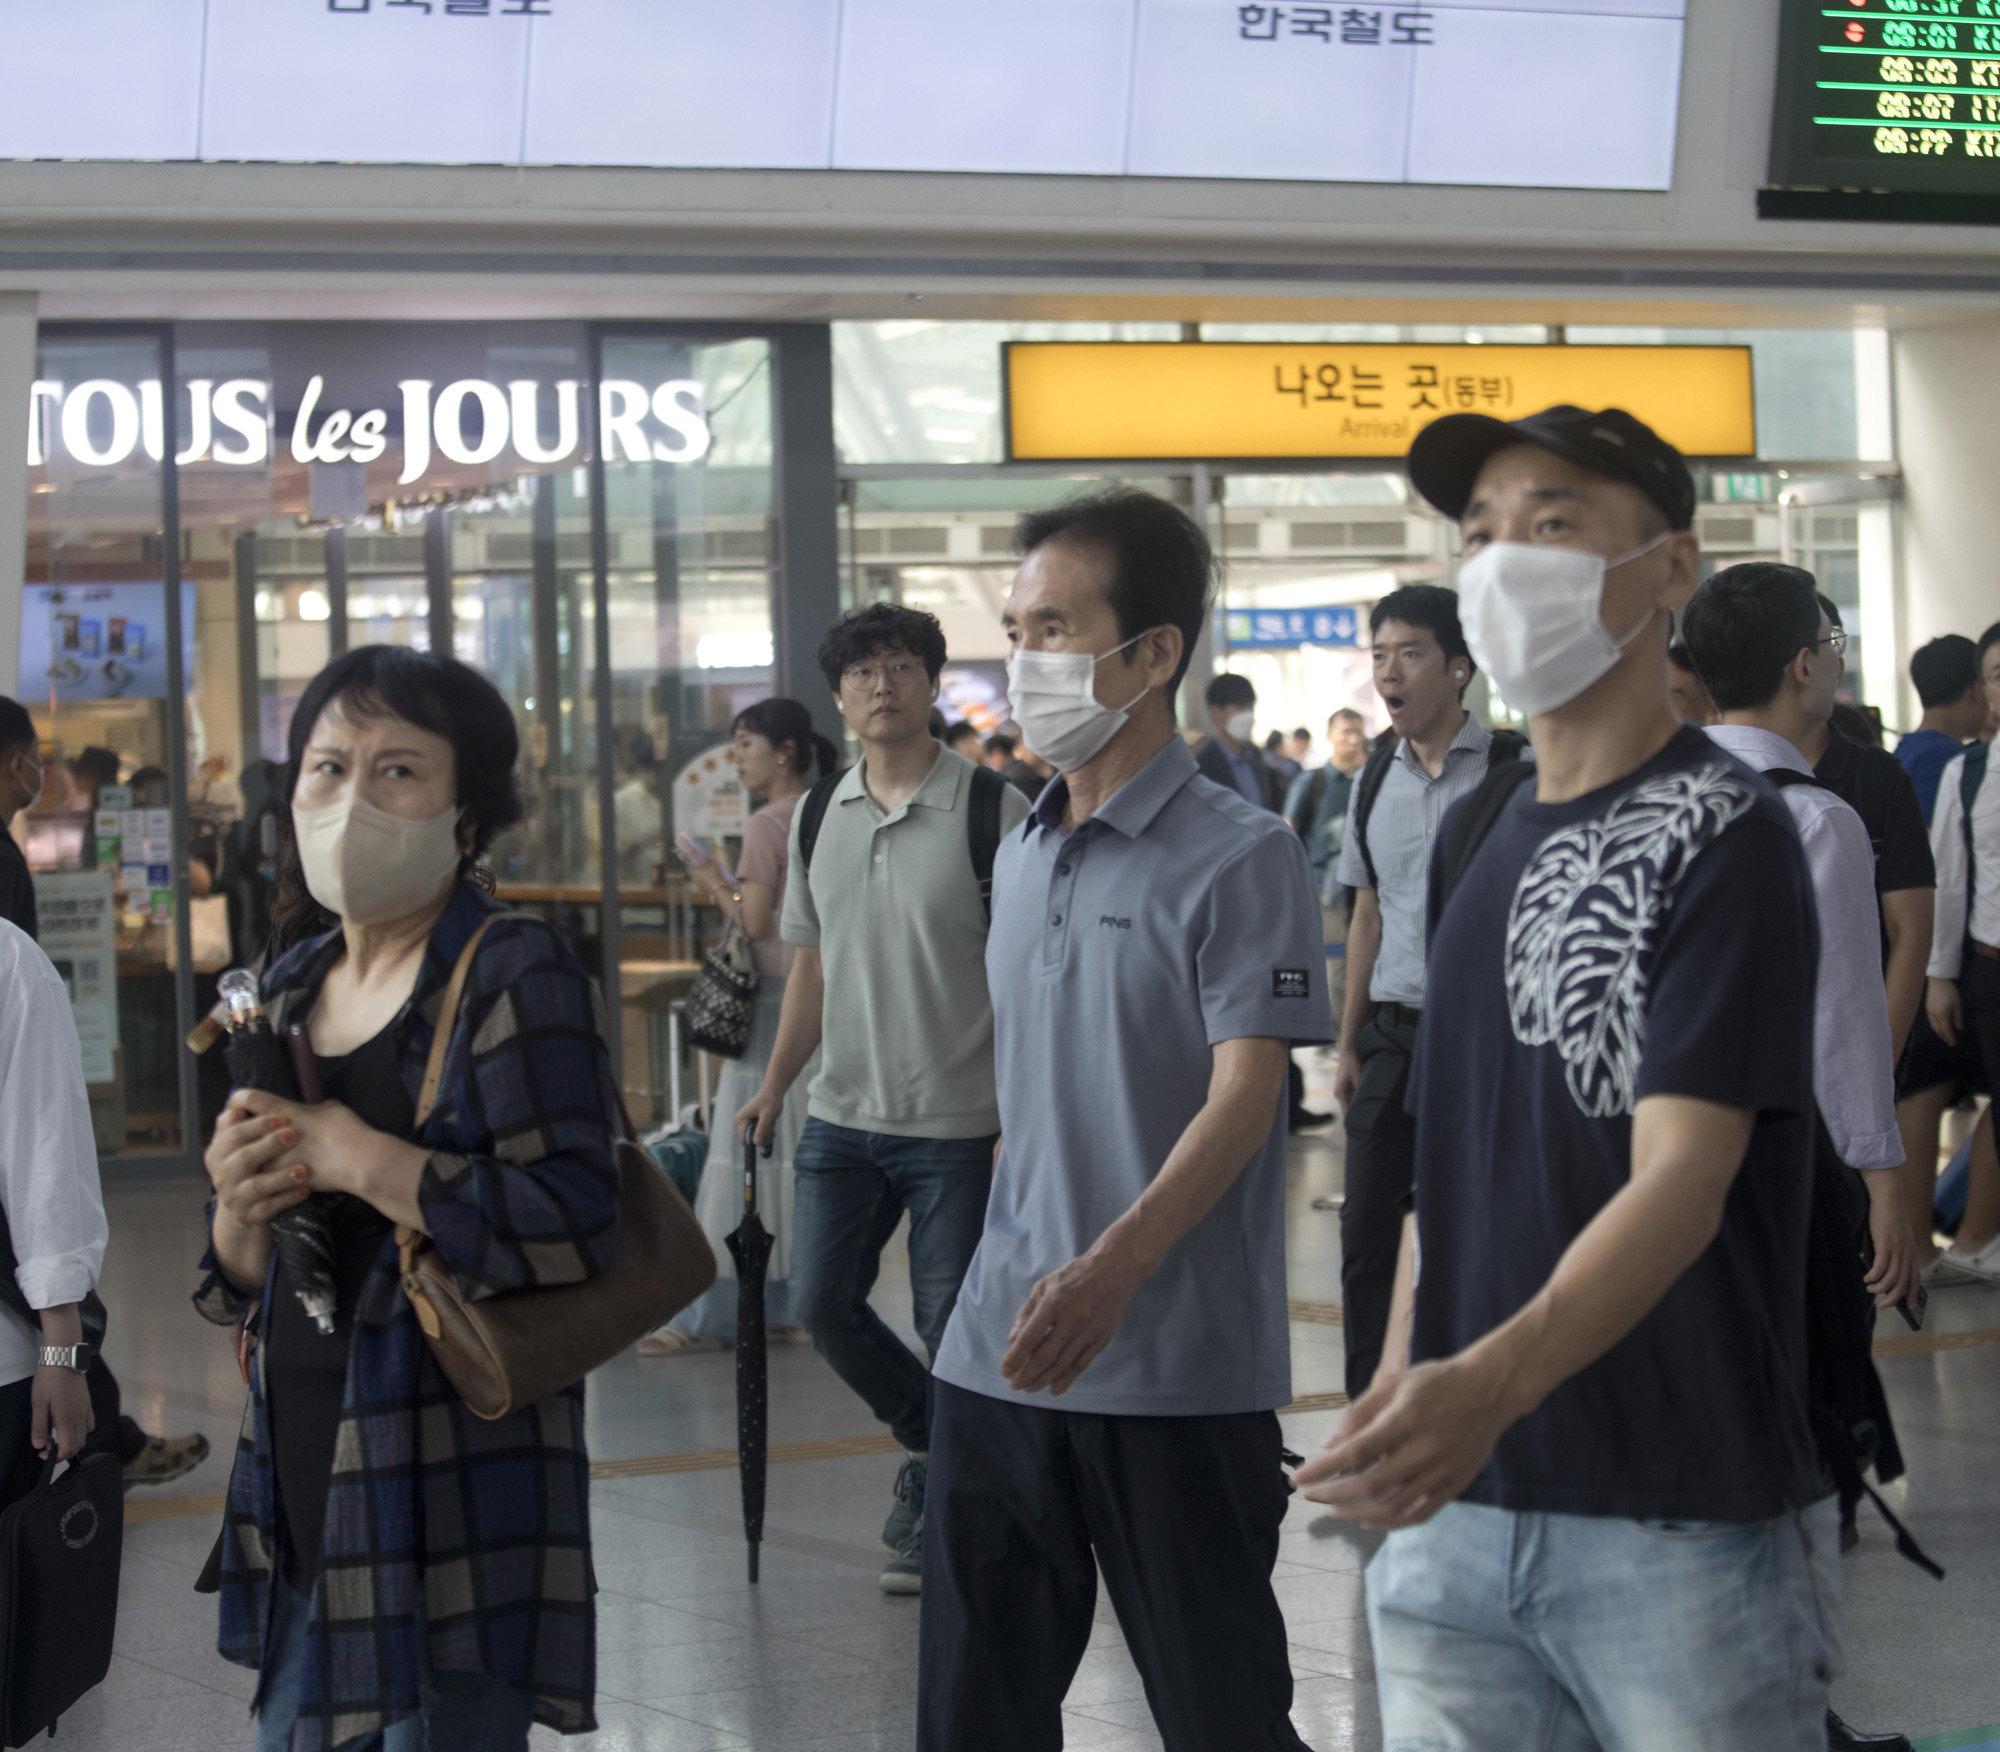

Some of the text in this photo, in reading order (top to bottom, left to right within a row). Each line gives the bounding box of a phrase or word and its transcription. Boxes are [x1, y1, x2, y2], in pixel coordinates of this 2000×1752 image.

[1238, 4, 1434, 45] 한국철도
[1274, 363, 1384, 409] 나오는
[27, 374, 711, 485] TOUS les JOURS
[1340, 416, 1409, 439] Arrival
